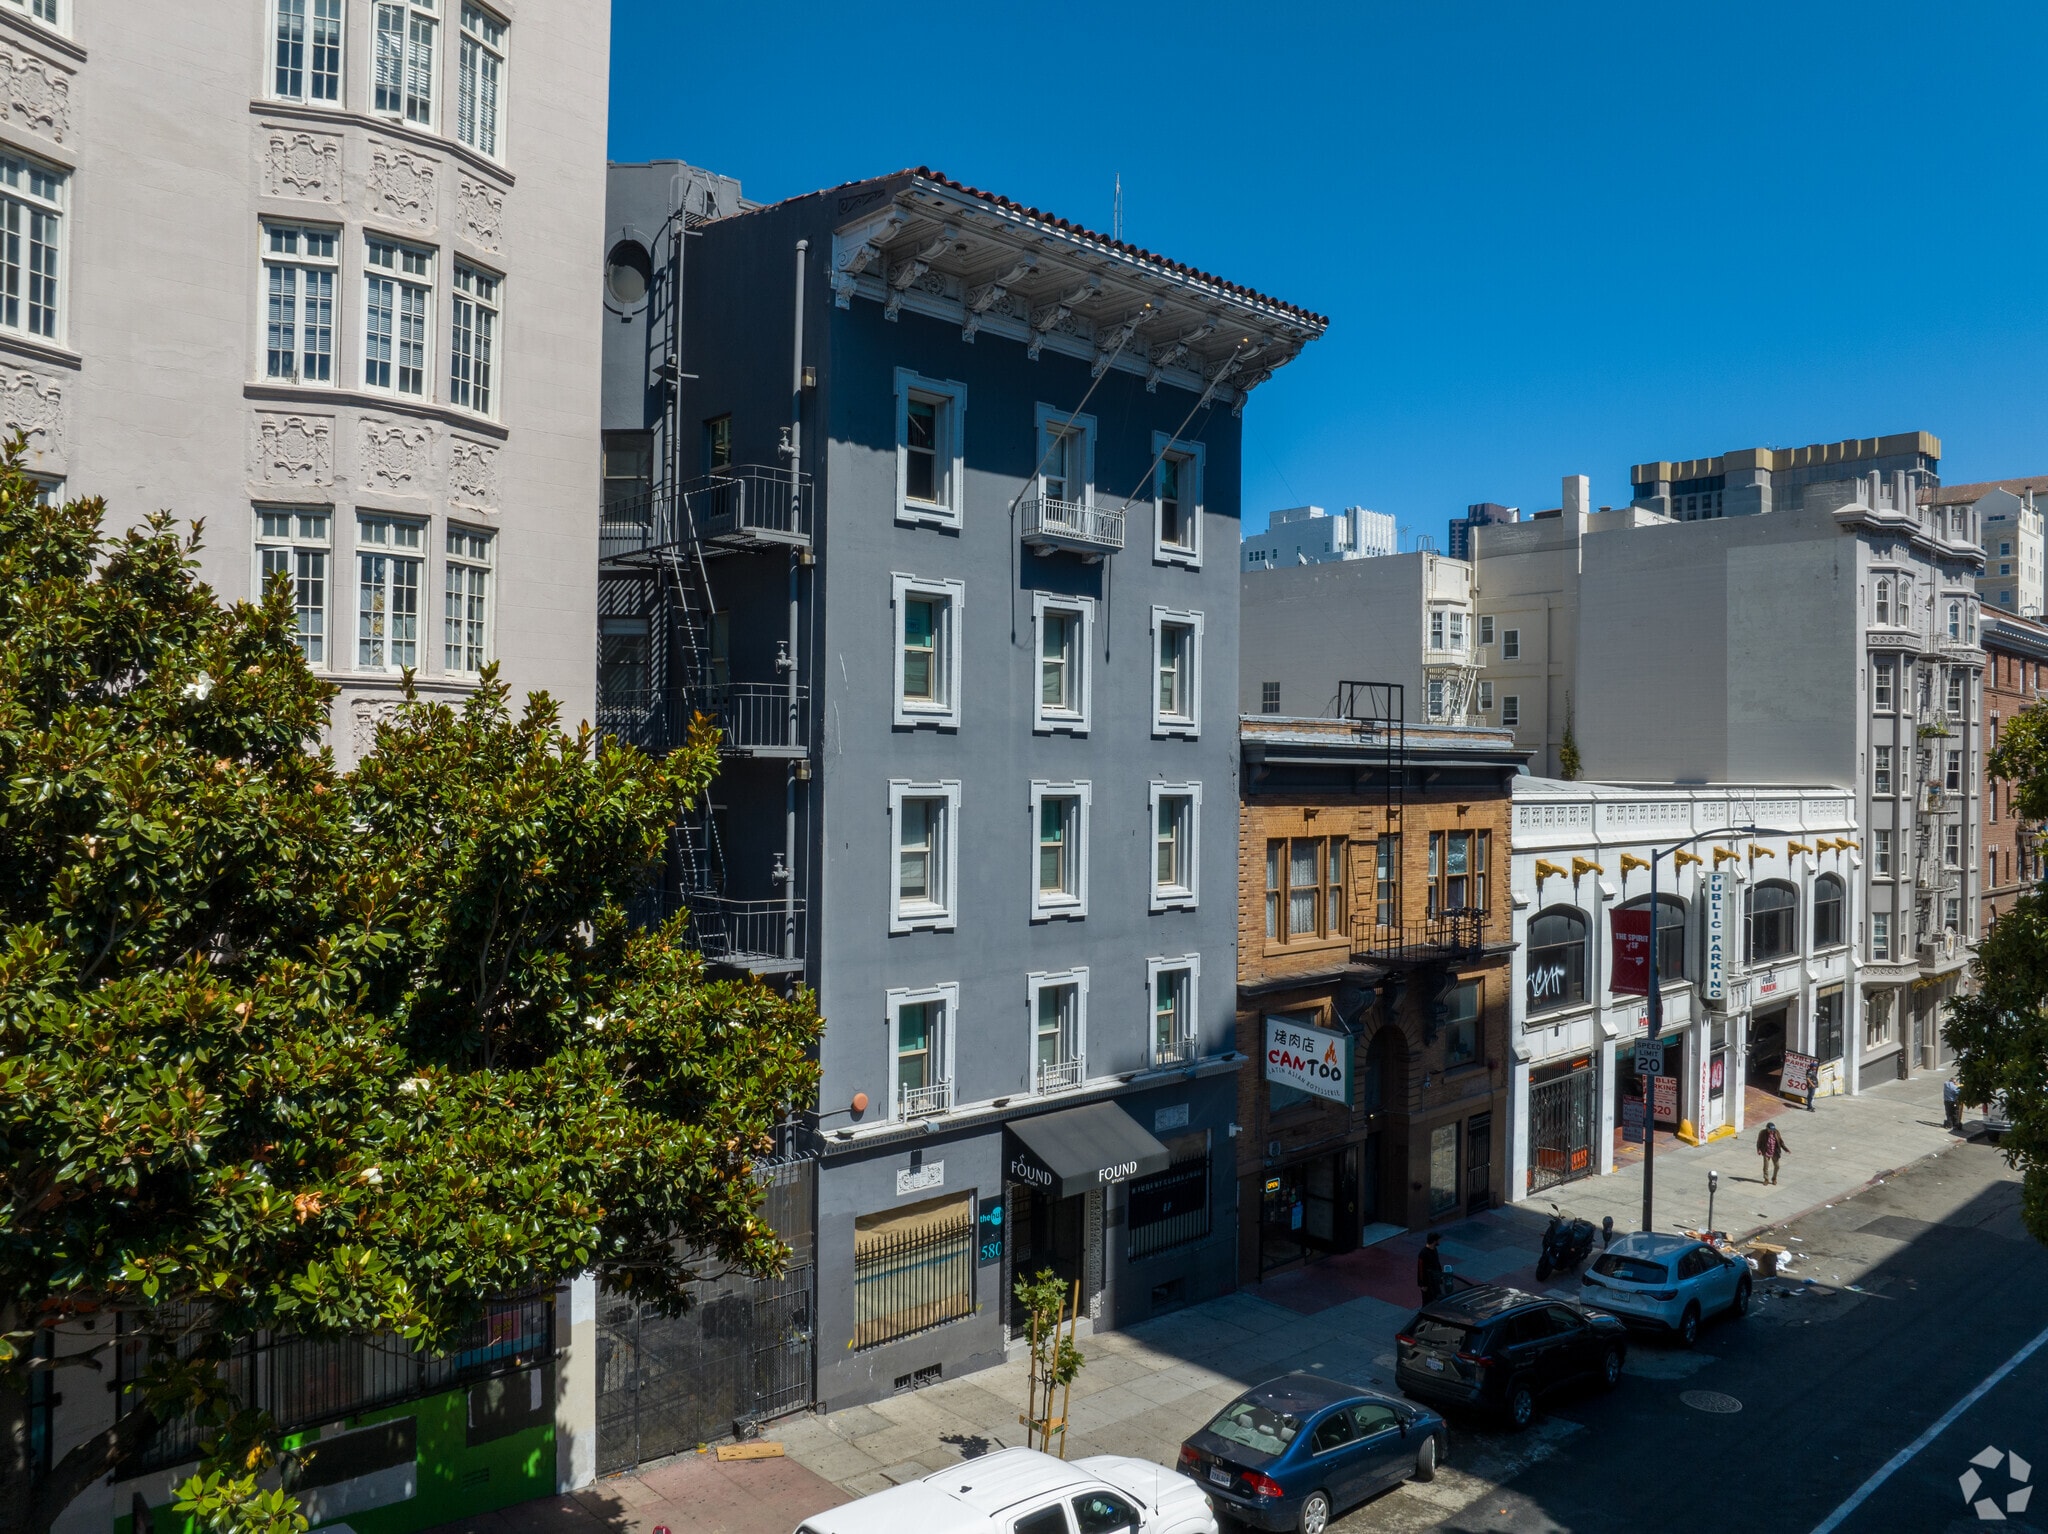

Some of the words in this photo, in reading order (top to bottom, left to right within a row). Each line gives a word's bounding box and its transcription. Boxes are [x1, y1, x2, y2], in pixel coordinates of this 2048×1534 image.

[1711, 874, 1722, 929] PUBLIC
[1615, 932, 1627, 940] THE
[1628, 933, 1649, 943] SPIRIT
[1710, 934, 1722, 998] PARKING
[1274, 1029, 1315, 1053] 烤肉店
[1637, 1042, 1661, 1050] SPEED
[1268, 1049, 1341, 1081] CANTOO
[1638, 1057, 1660, 1072] 20
[1268, 1066, 1286, 1075] LATIN
[1288, 1070, 1306, 1083] ASIAN
[1787, 1078, 1808, 1091] $20
[1011, 1160, 1052, 1186] FOUND
[1098, 1161, 1137, 1182] FOUND
[980, 1214, 991, 1223] the
[981, 1241, 1002, 1260] 580
